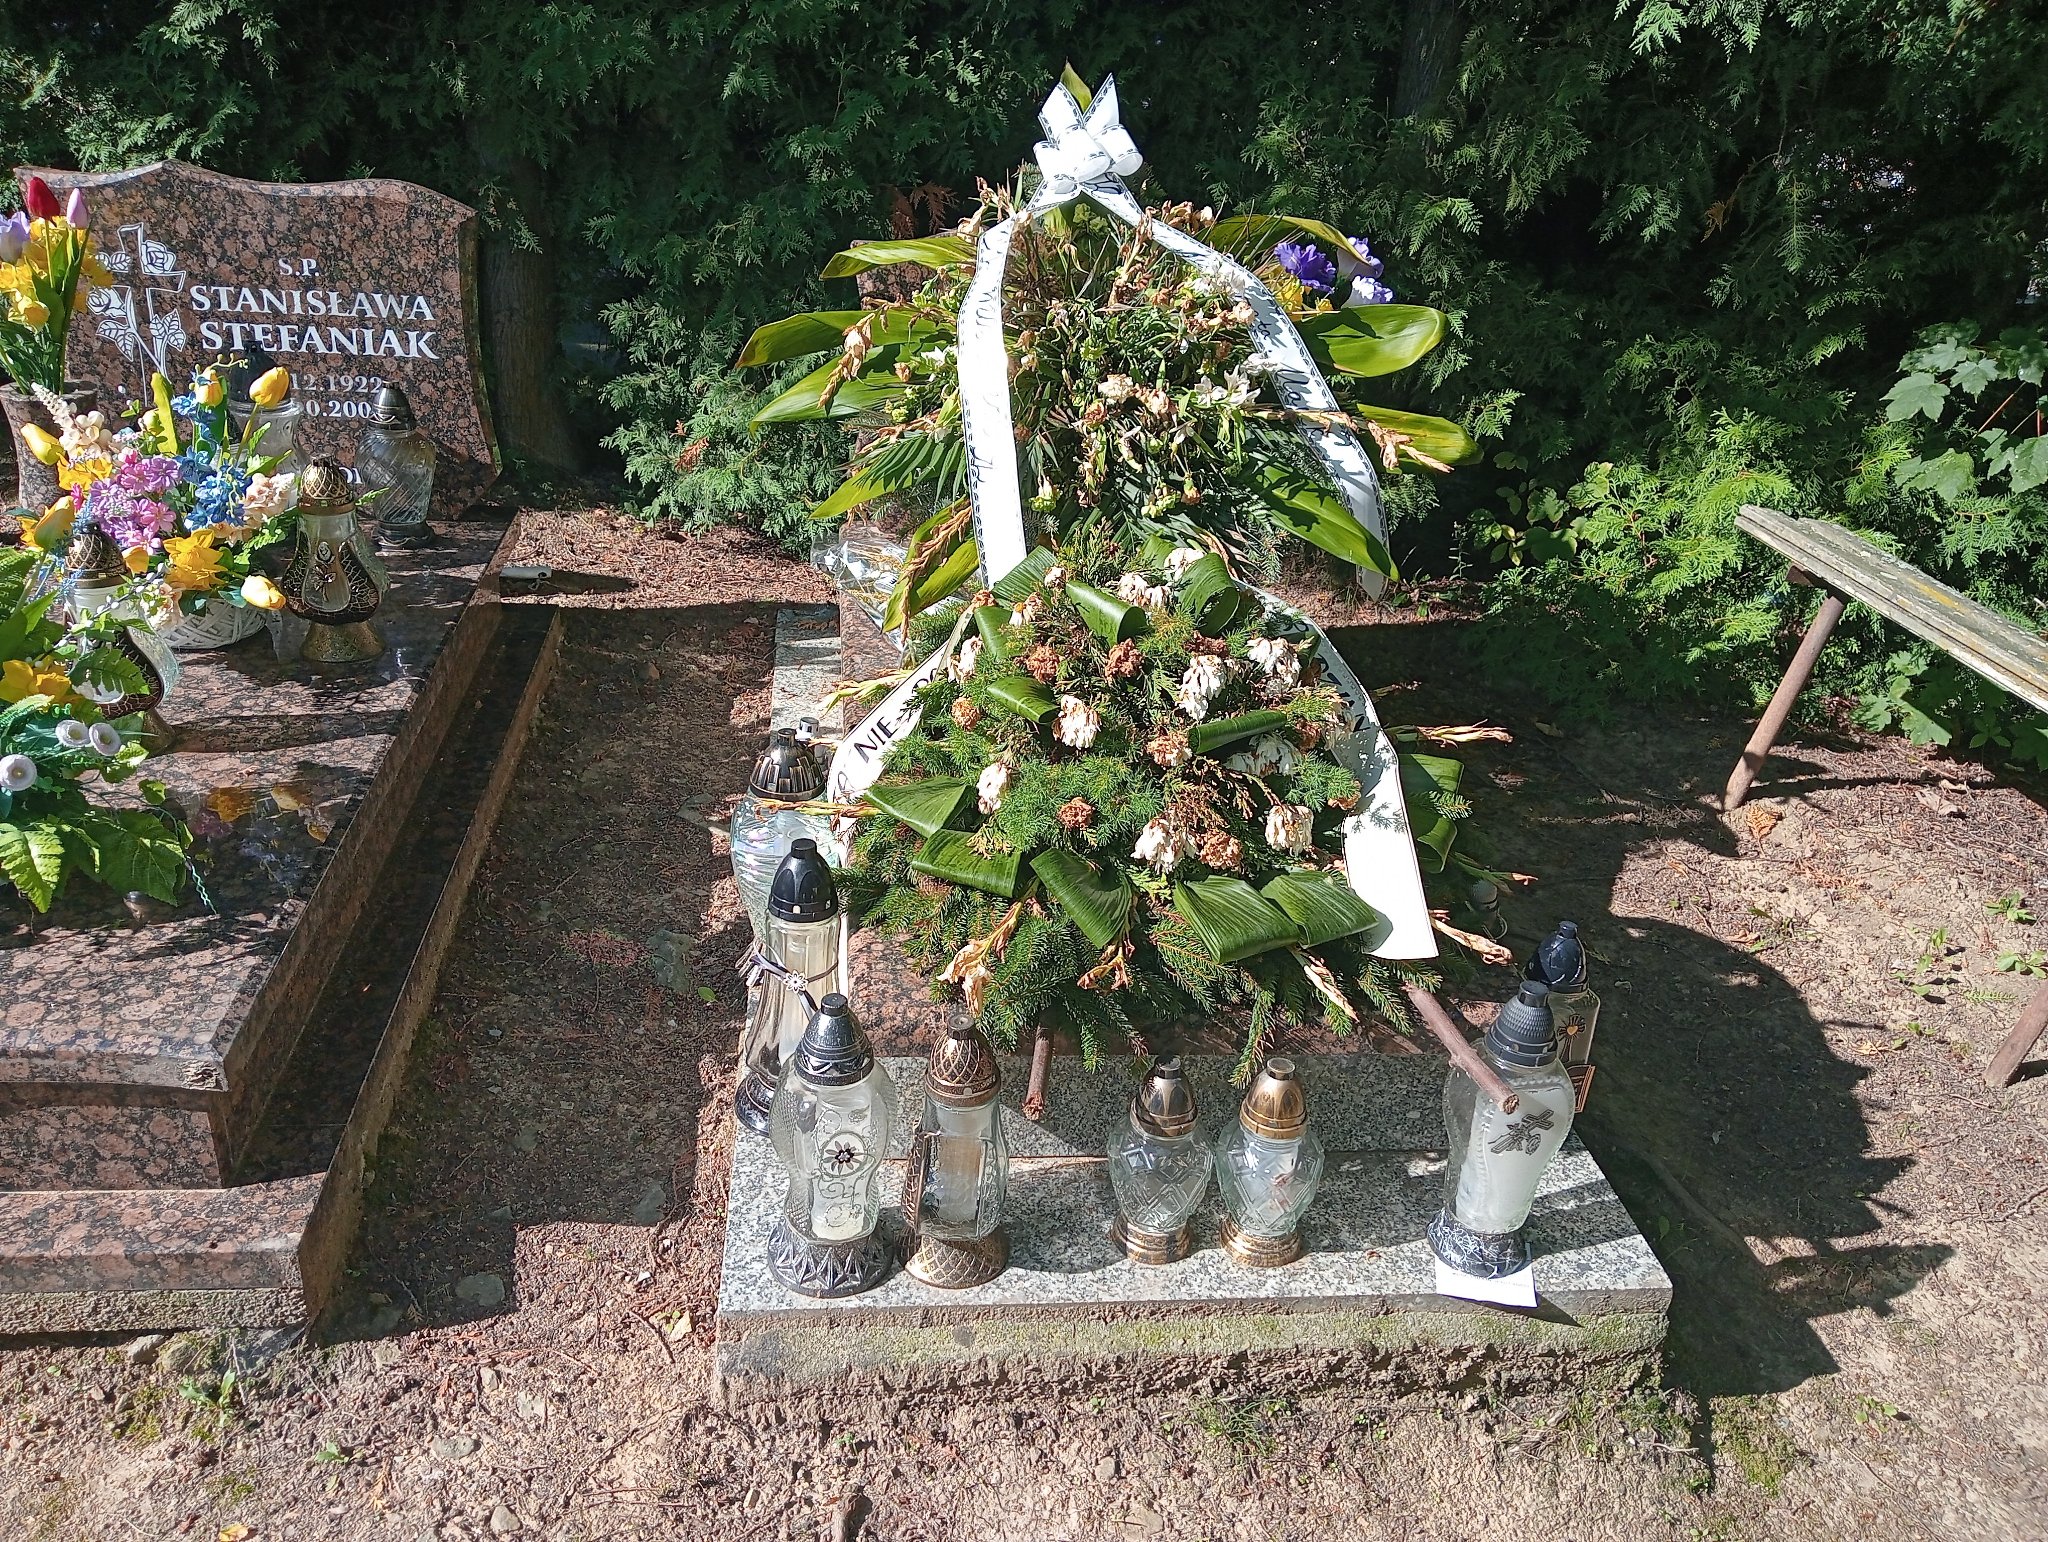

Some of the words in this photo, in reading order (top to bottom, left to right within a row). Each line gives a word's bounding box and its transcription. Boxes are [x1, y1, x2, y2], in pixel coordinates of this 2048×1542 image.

[190, 285, 437, 321] STANISŁAWA
[200, 321, 440, 360] STEFANIAK
[290, 373, 382, 394] 12.1922
[305, 399, 372, 419] 0.200
